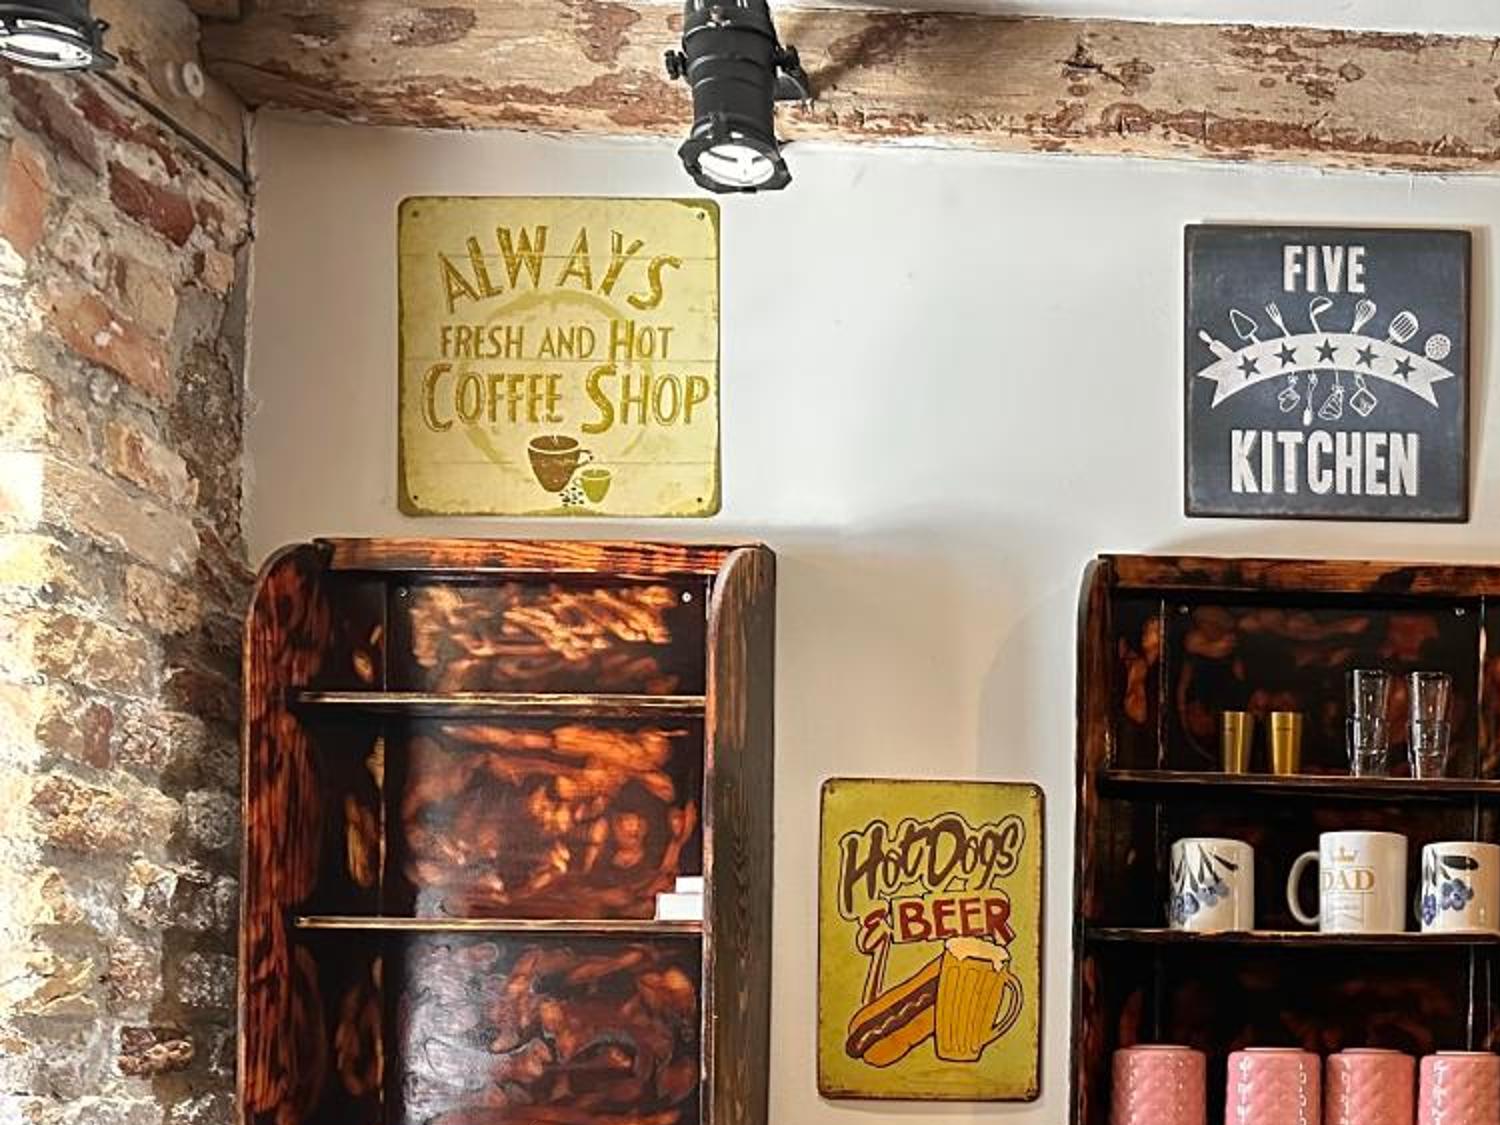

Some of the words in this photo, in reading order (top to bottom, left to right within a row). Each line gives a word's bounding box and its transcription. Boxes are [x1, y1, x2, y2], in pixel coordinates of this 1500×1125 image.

[438, 225, 681, 313] ALWAYS
[1283, 245, 1366, 293] FIVE
[440, 326, 525, 359] FRESH
[537, 326, 596, 359] AND
[609, 319, 674, 367] HOT
[422, 364, 564, 432] COFFEE
[581, 365, 711, 434] SHOP
[1231, 429, 1420, 496] KITCHEN
[1321, 869, 1375, 891] DAD
[899, 897, 1016, 946] BEER
